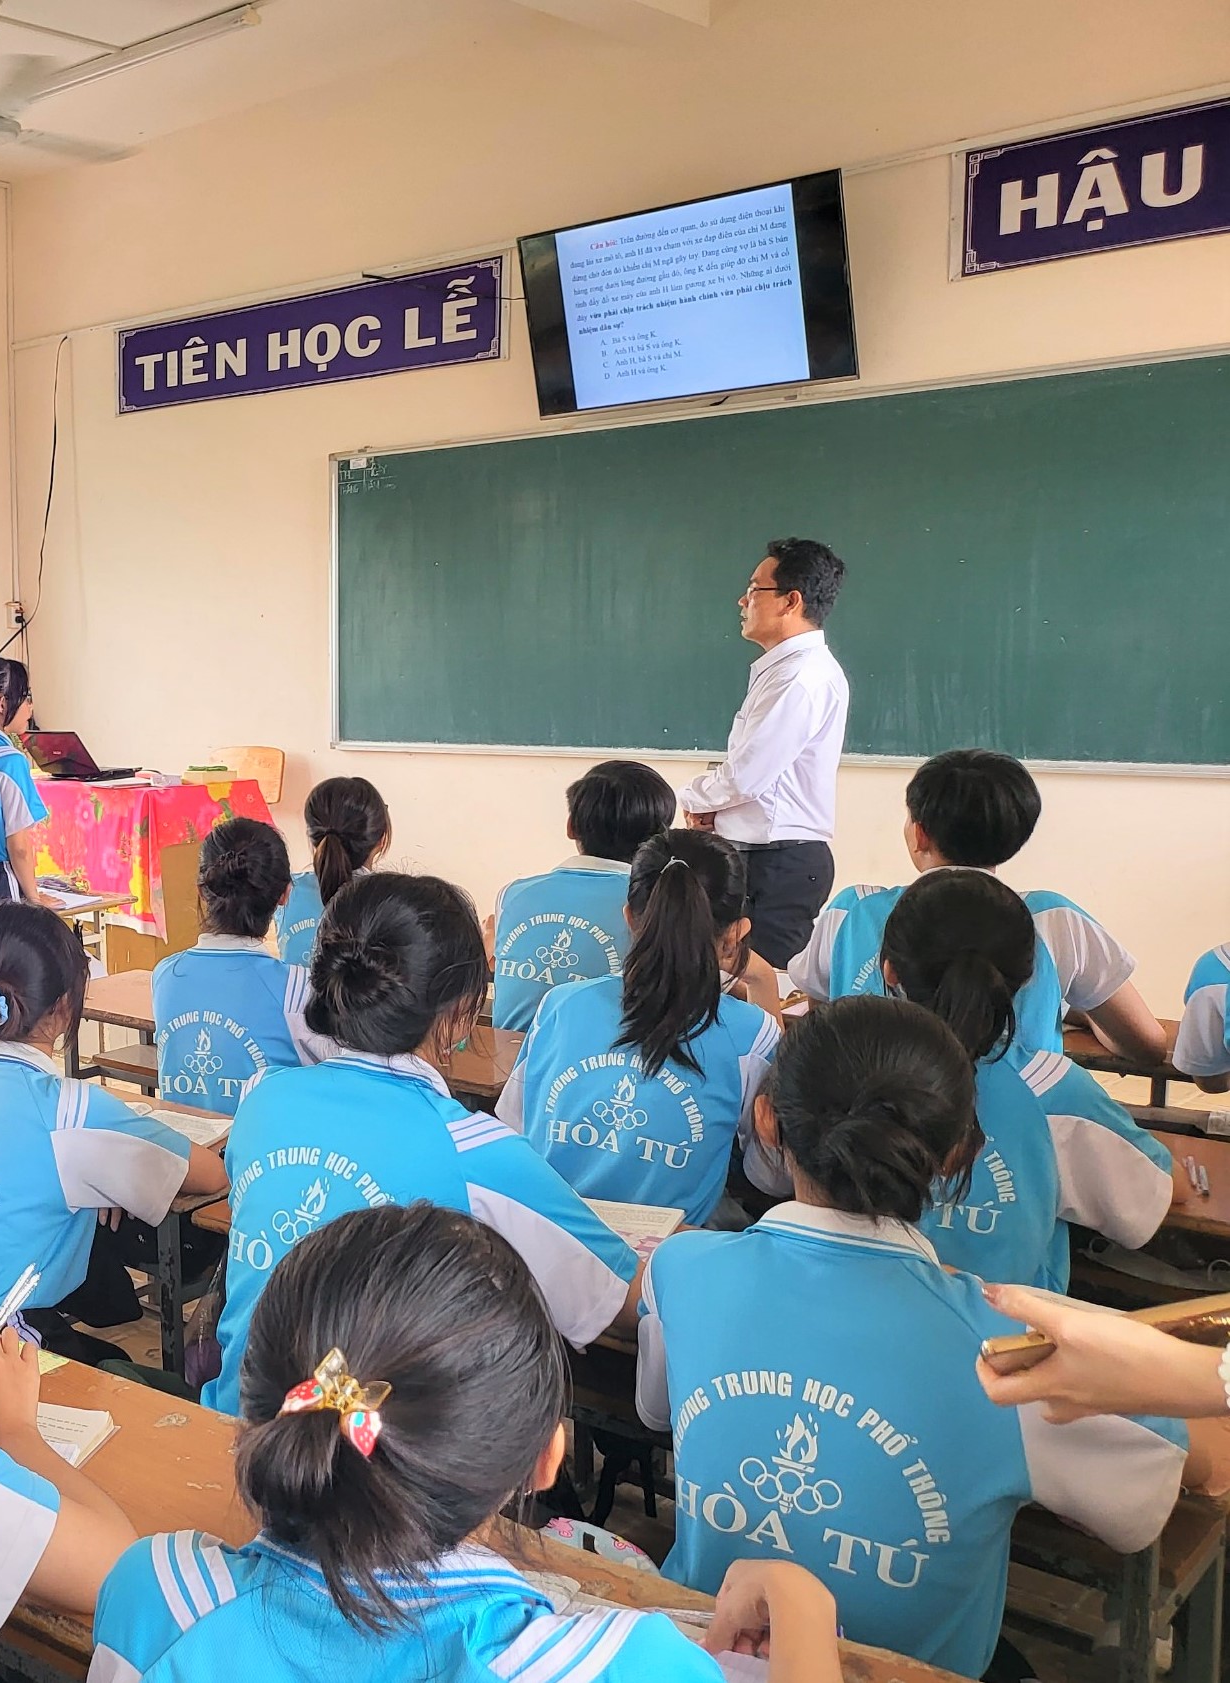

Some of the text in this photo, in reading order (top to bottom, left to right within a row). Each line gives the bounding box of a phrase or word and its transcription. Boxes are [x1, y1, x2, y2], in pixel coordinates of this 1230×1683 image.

[999, 144, 1204, 236] HẬU
[134, 275, 479, 392] TIÊN HỌC LỄ
[499, 958, 555, 985] HÒA
[529, 913, 566, 927] TRUNG
[568, 916, 590, 930] HỌC
[604, 944, 623, 976] THÔN
[167, 1010, 200, 1033] TRUNG
[202, 1010, 223, 1026] HỌC
[243, 1036, 268, 1070] THÔN
[580, 1052, 626, 1073] TRUNG
[680, 1094, 704, 1143] THÔNG
[267, 1146, 321, 1170] TRUNG
[324, 1151, 359, 1181] HỌC
[547, 1116, 693, 1169] HÒA TÚ
[983, 1149, 1017, 1203] THÔNG
[932, 1200, 1003, 1234] TÚ
[230, 1228, 273, 1270] HÒ
[711, 1370, 793, 1401] TRUNG
[802, 1378, 855, 1418] HỌC
[856, 1407, 919, 1457] PHỔ
[901, 1458, 951, 1544] THÔNG
[675, 1473, 931, 1589] HÒA TÚ
